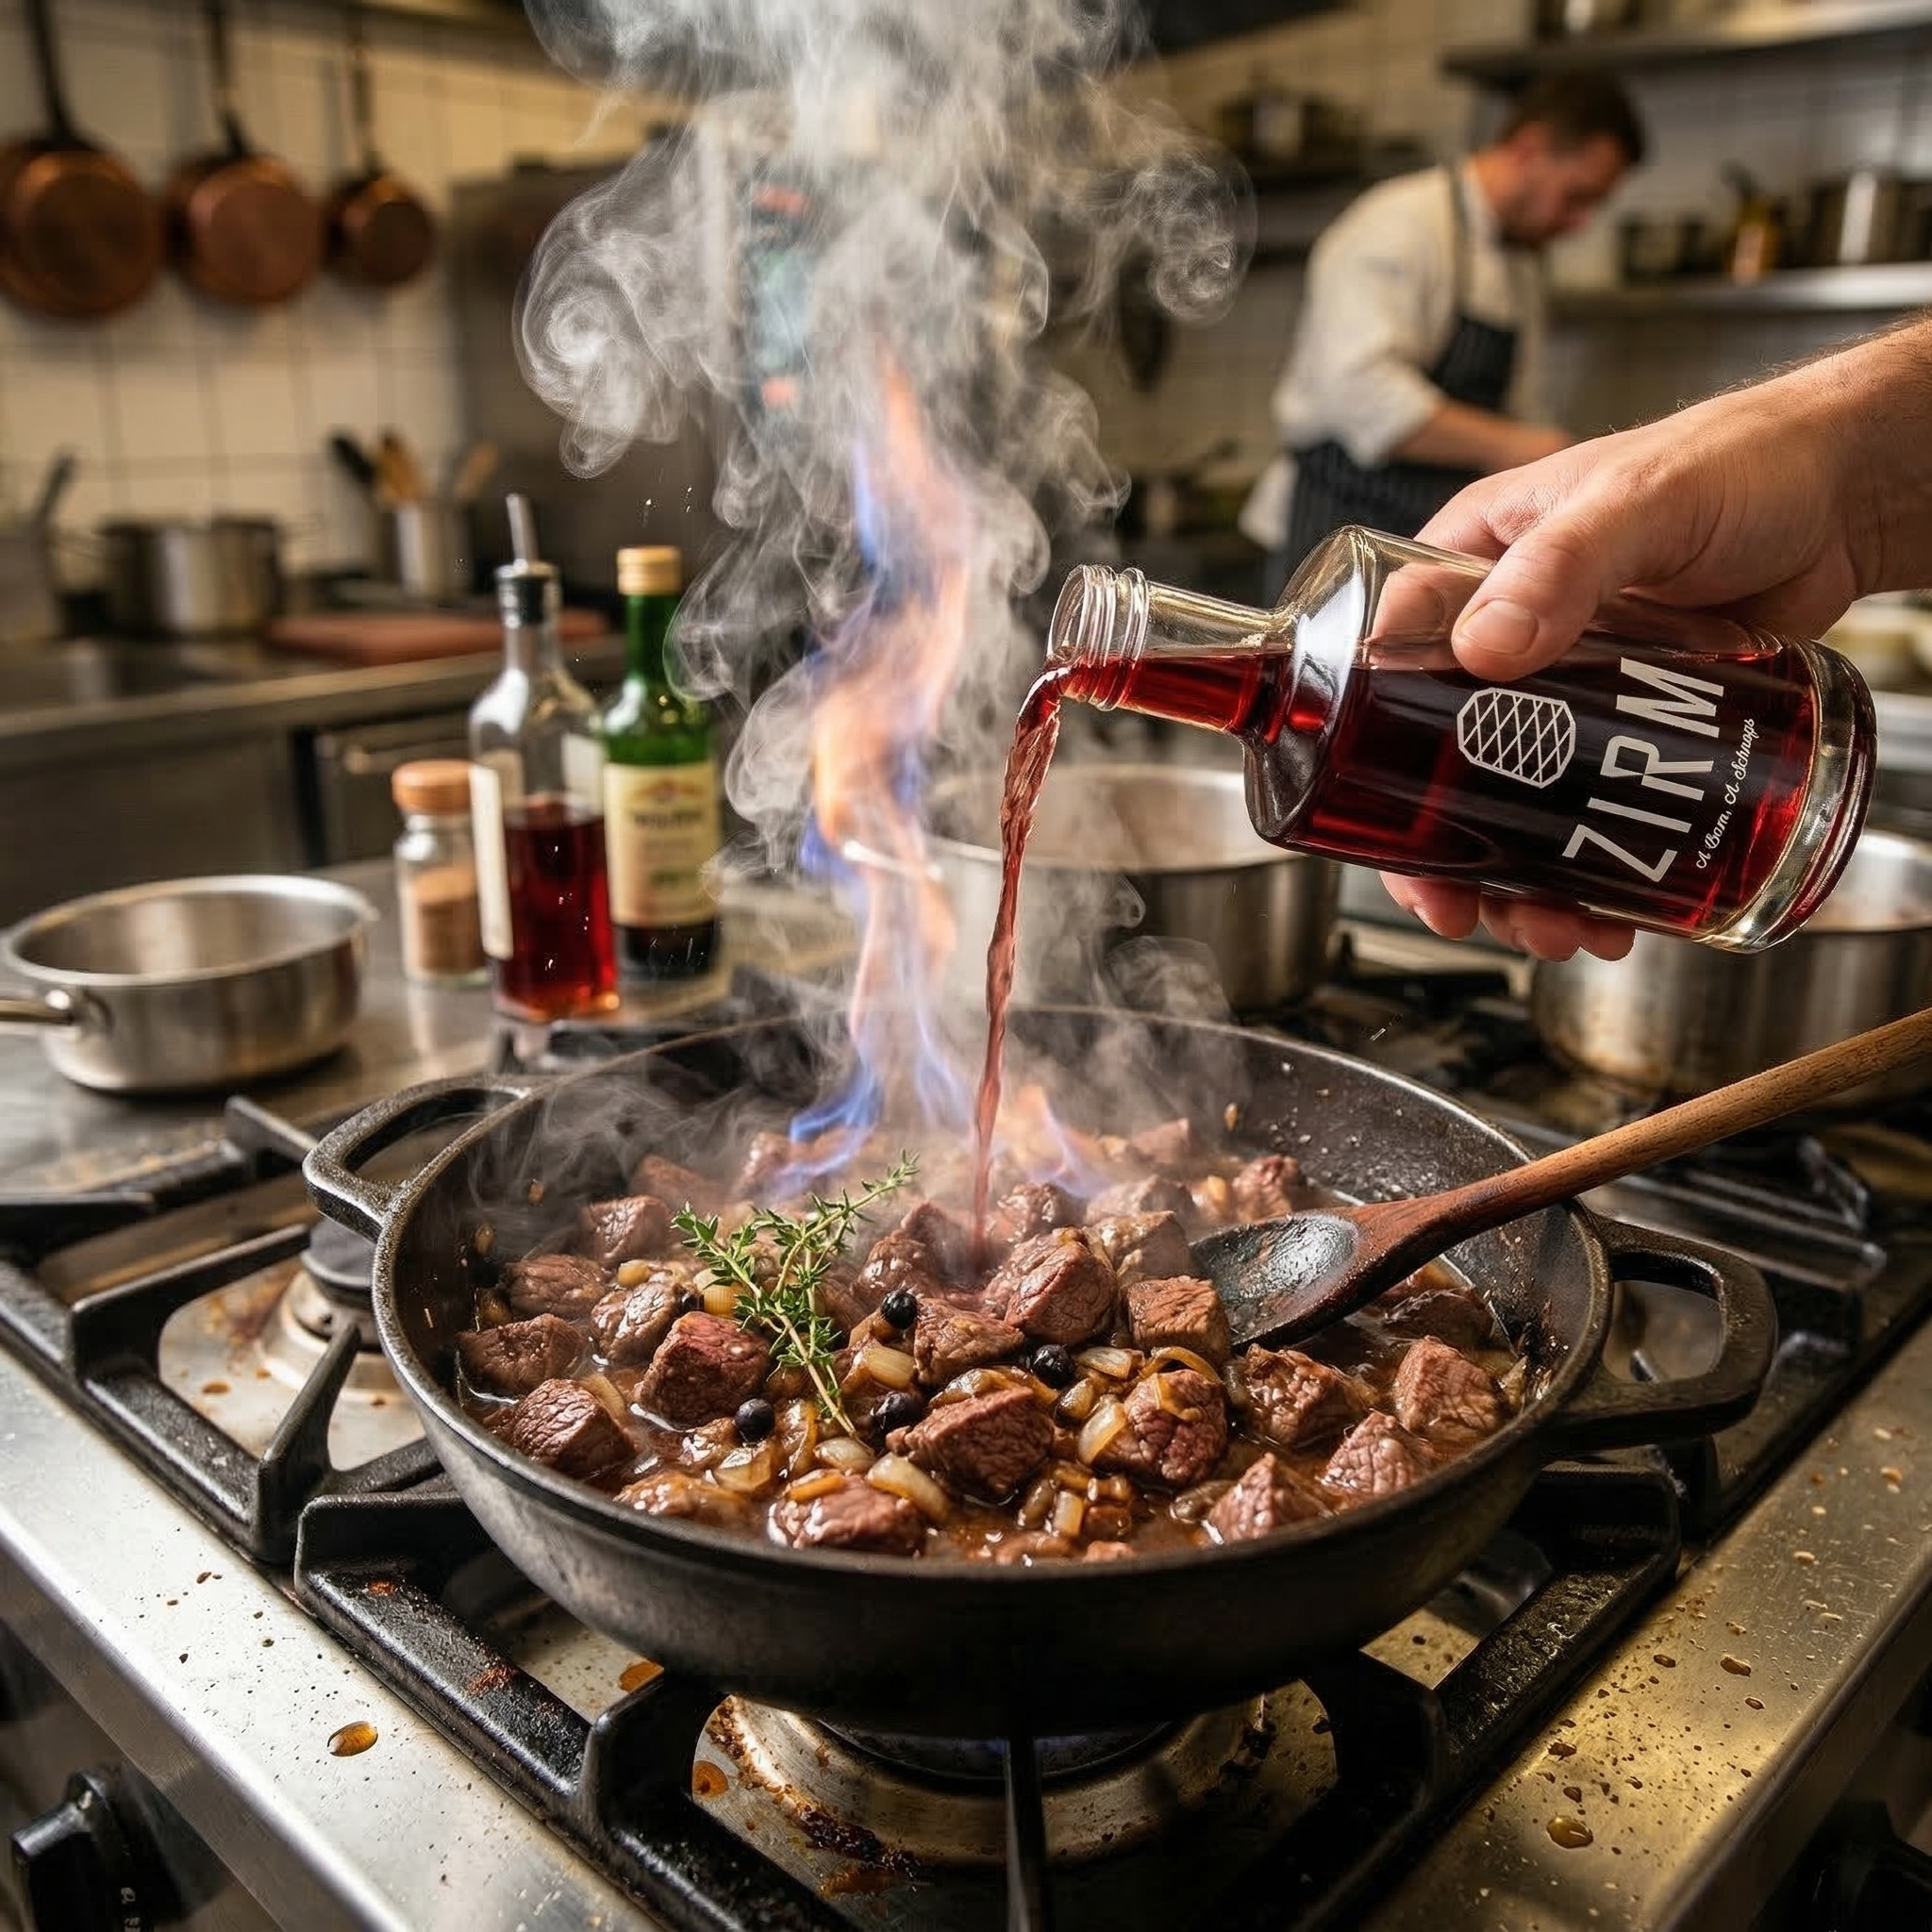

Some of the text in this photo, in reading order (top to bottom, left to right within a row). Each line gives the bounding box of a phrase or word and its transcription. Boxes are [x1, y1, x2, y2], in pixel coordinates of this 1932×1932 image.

[1561, 658, 1724, 883] ZIRM
[1696, 851, 1711, 869] A
[1724, 782, 1740, 805] A
